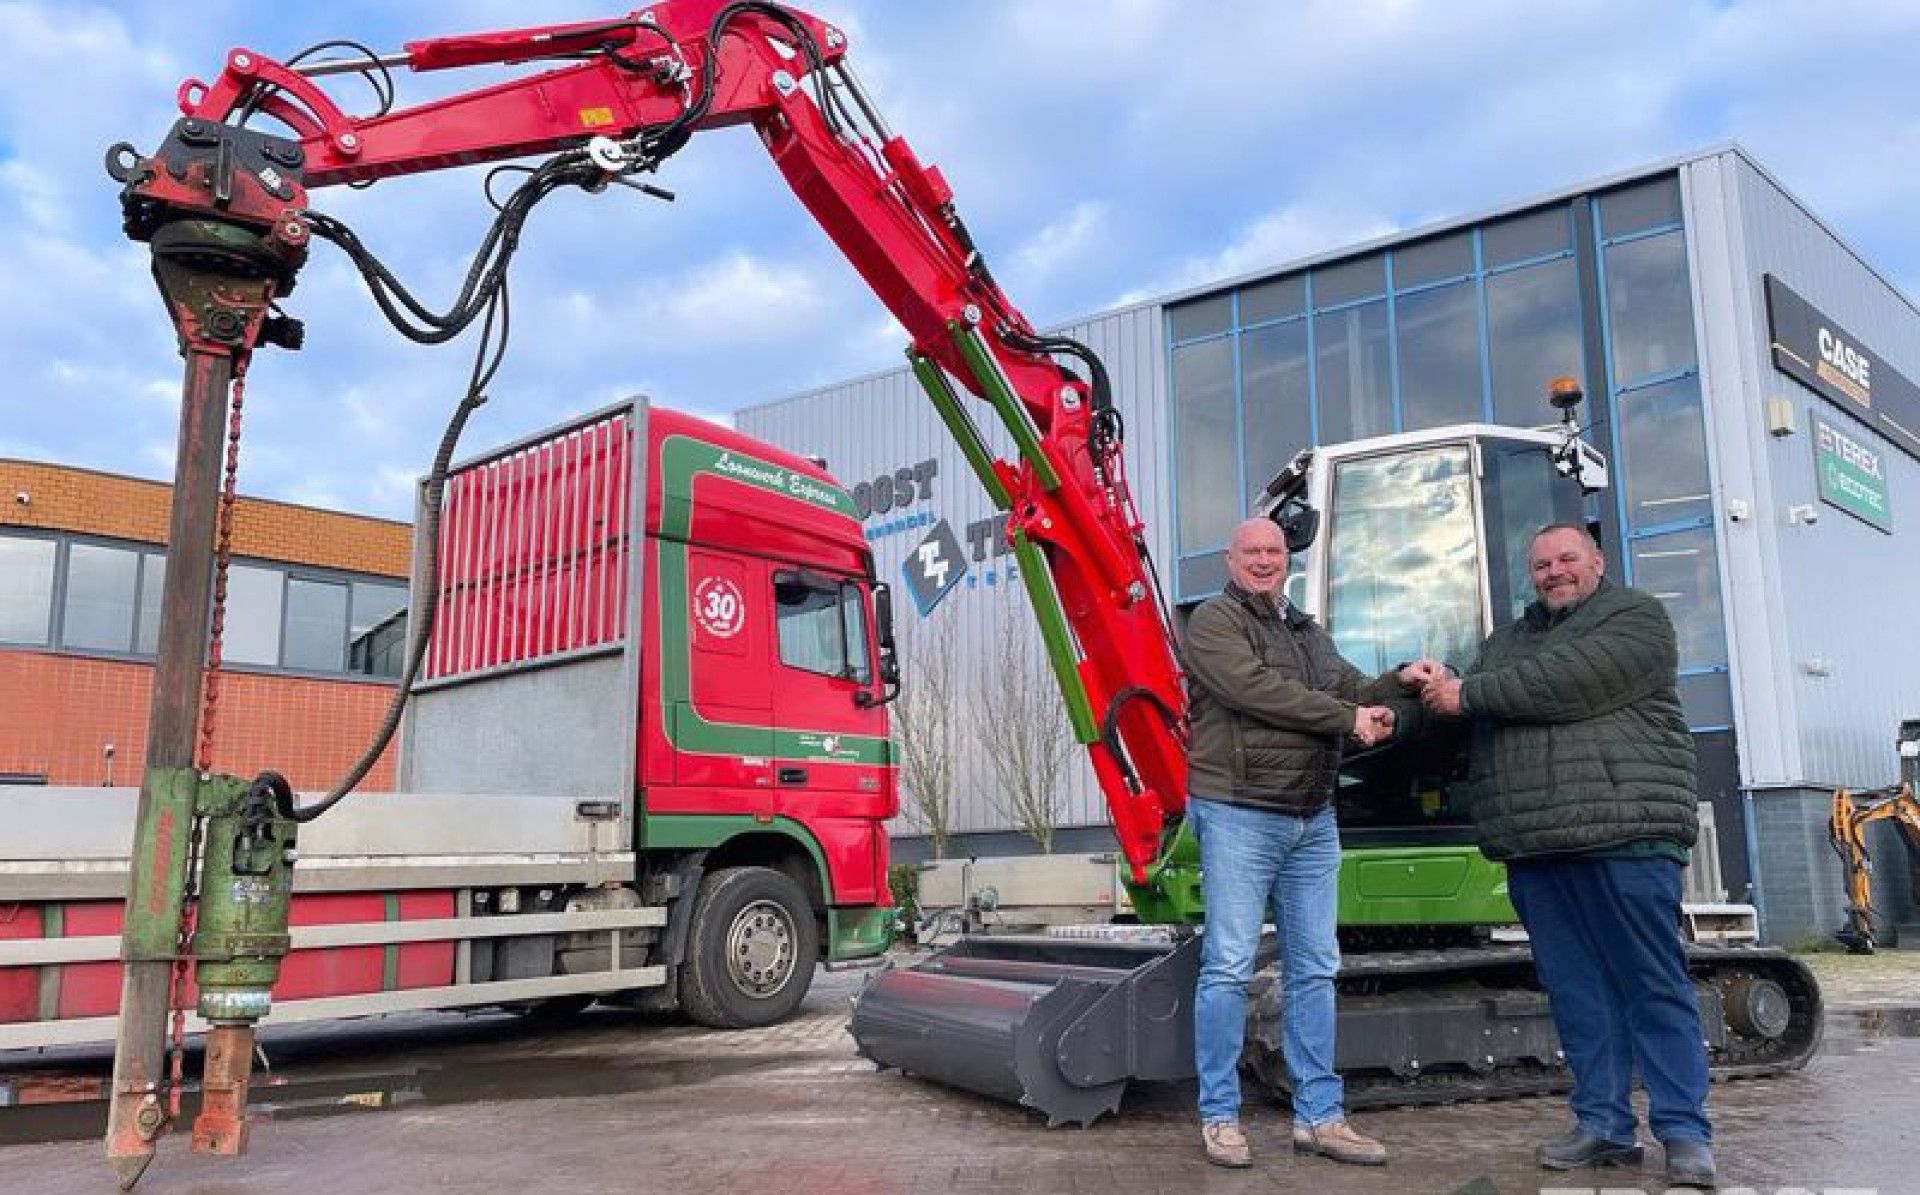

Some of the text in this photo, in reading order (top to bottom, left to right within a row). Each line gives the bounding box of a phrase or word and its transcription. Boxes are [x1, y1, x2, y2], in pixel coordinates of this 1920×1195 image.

[1818, 327, 1870, 389] CASE
[853, 458, 937, 521] OOST
[704, 591, 735, 620] 30
